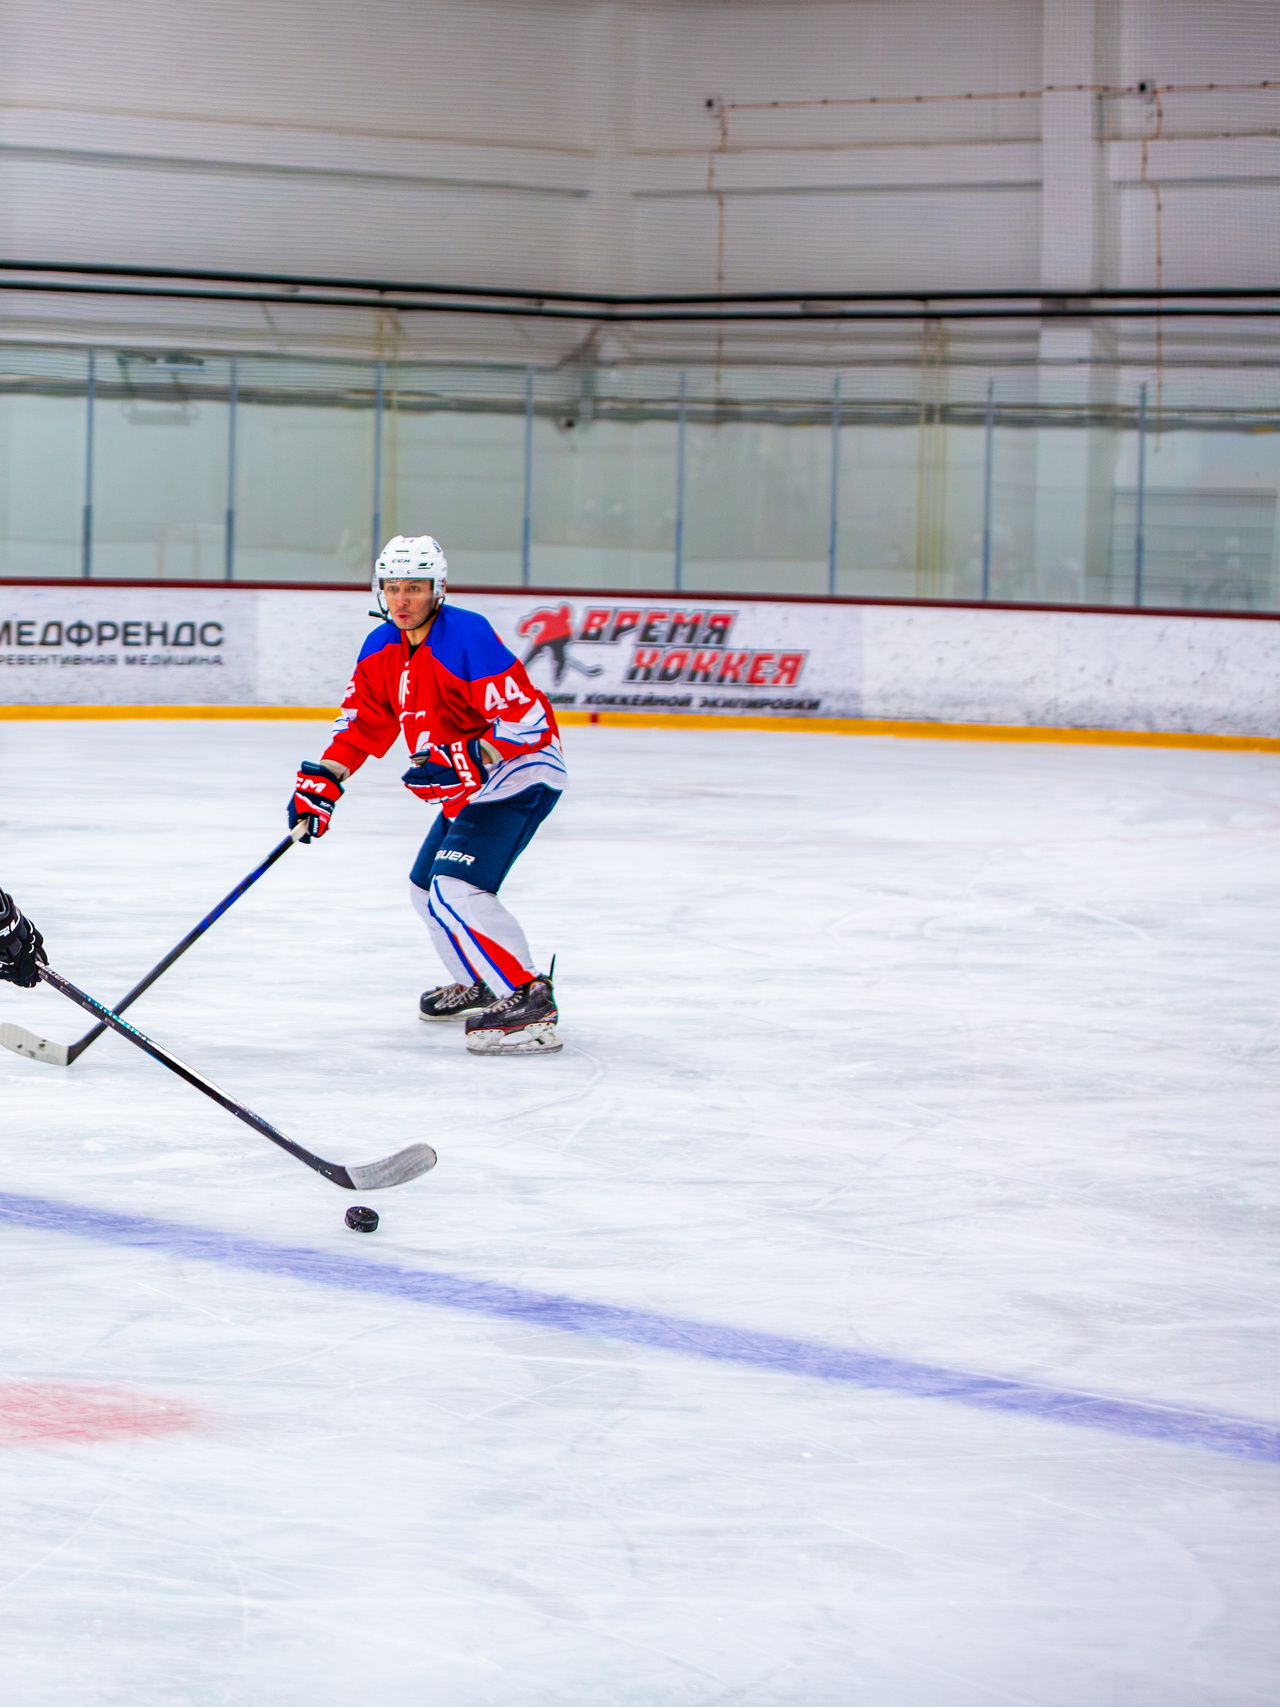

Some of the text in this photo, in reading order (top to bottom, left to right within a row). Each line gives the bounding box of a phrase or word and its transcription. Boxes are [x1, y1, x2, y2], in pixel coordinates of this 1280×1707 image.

[577, 607, 738, 646] ВРЕМЯ
[124, 654, 223, 667] МЕДИЦИНА
[624, 648, 806, 686] ХОККЕЯ
[483, 676, 531, 712] 44
[583, 693, 691, 708] ХОККЕЙНОЙ
[699, 695, 820, 710] ЭКИПИРОВКИ
[451, 741, 477, 787] CCM
[435, 849, 476, 866] AUER
